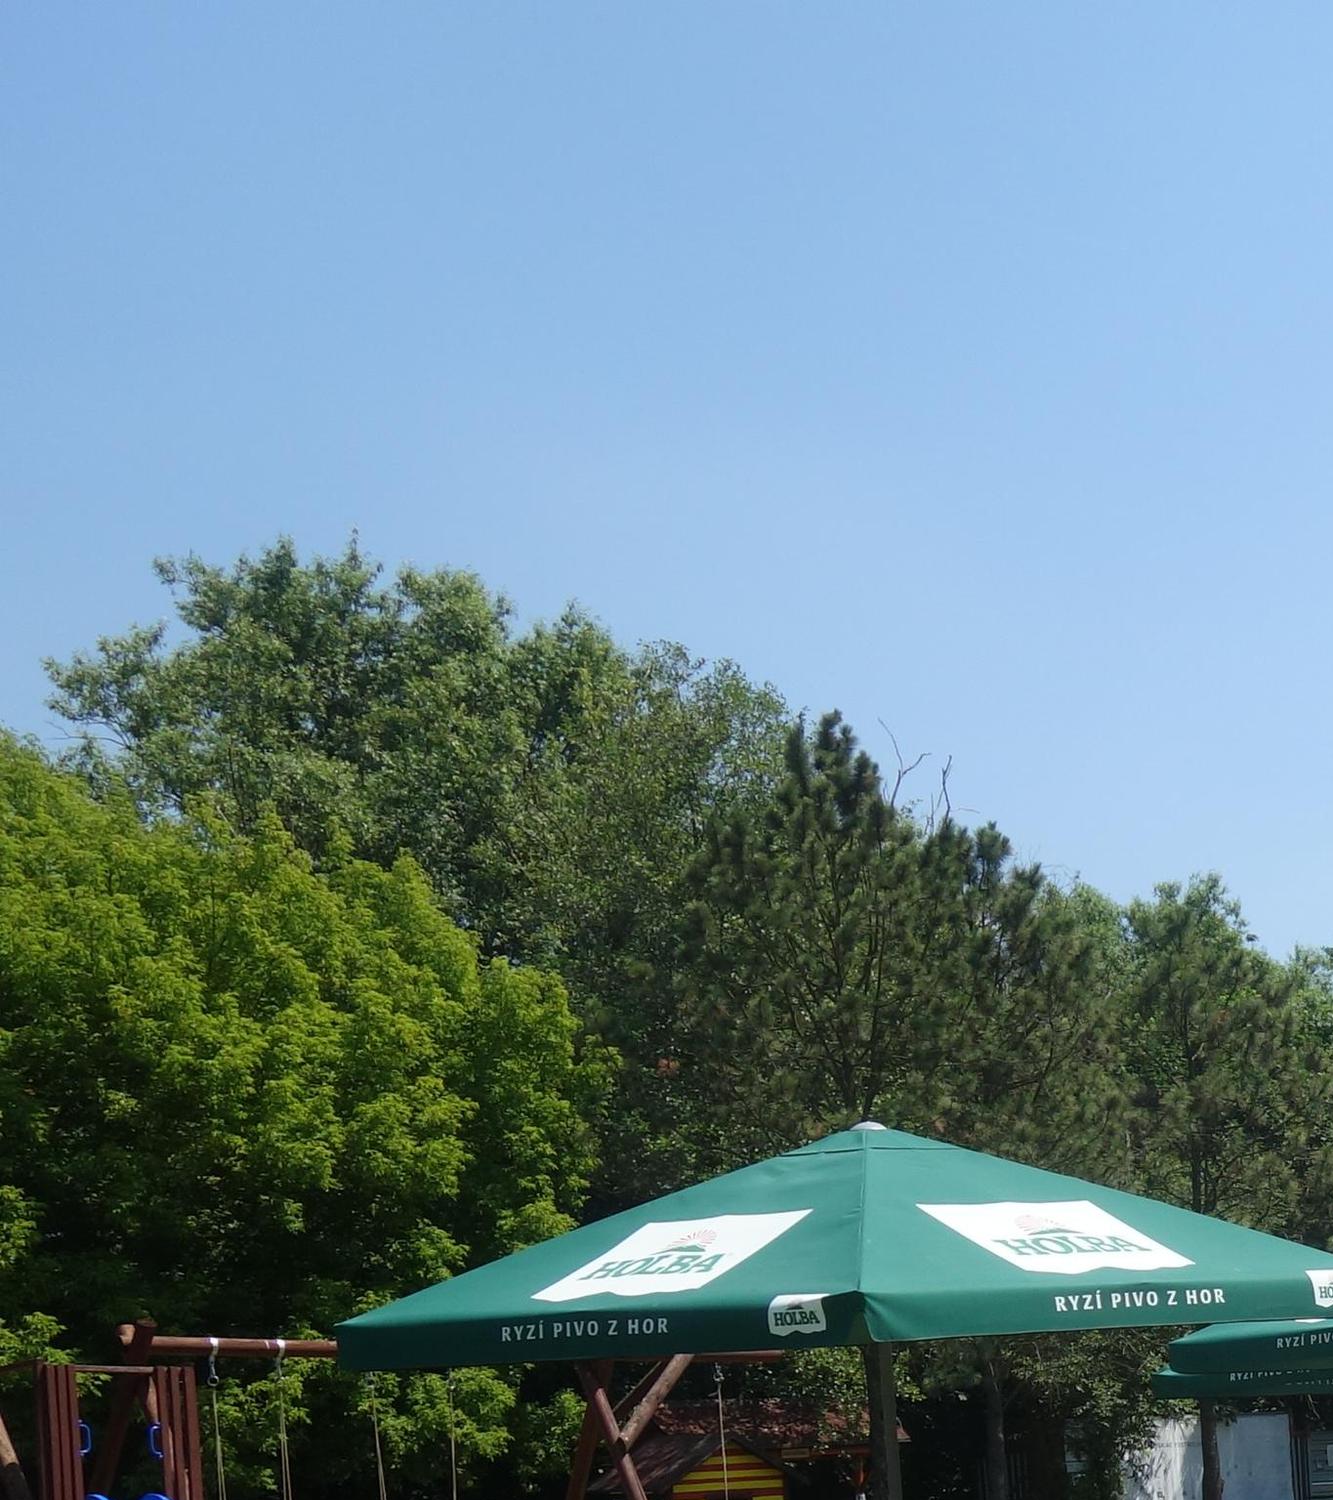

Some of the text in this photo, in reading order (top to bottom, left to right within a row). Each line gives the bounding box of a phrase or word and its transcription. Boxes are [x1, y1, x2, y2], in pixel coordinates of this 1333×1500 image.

[992, 1236, 1151, 1256] HOLBA
[577, 1253, 725, 1280] HOLBA
[1055, 1289, 1225, 1312] RYZÍ PIVO Z HOR
[774, 1310, 820, 1327] HOLBA
[501, 1318, 668, 1342] RYZÍ PIVO Z HOR
[1276, 1334, 1305, 1349] RYZÍ
